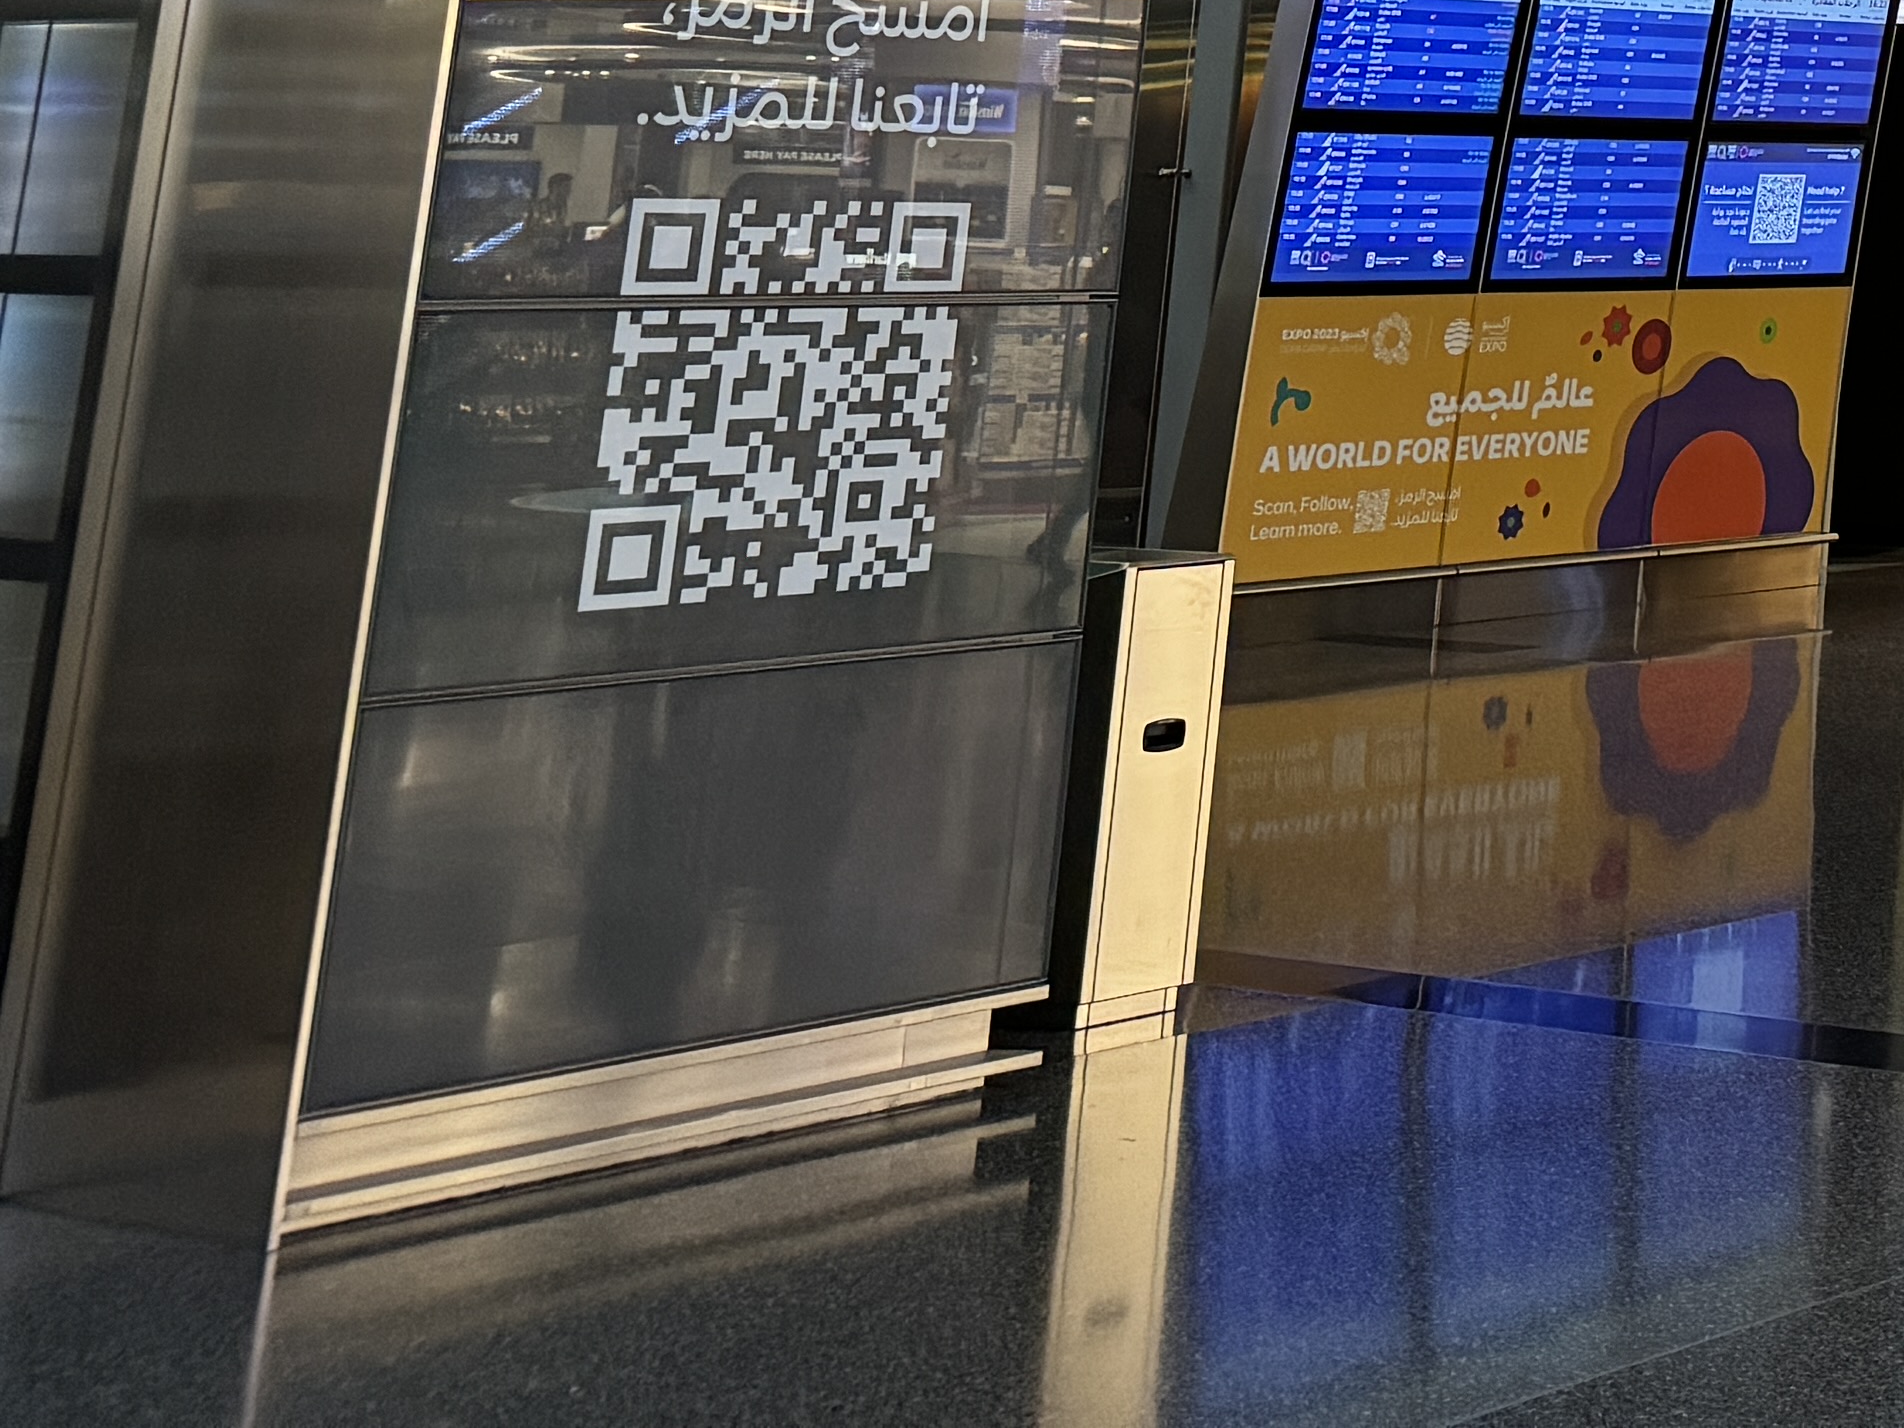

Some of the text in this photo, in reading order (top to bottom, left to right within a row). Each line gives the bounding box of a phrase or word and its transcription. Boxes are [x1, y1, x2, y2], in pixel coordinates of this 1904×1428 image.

[637, 73, 986, 148] تابعنا للمزيد.
[1282, 328, 1339, 341] EXPO 2023
[1478, 340, 1507, 354] EXPO
[1426, 379, 1531, 428] للجميع
[1259, 428, 1591, 474] A WORLD FOR EVERYONE
[1252, 500, 1298, 516] Scan,
[1250, 521, 1343, 542] Learn more.
